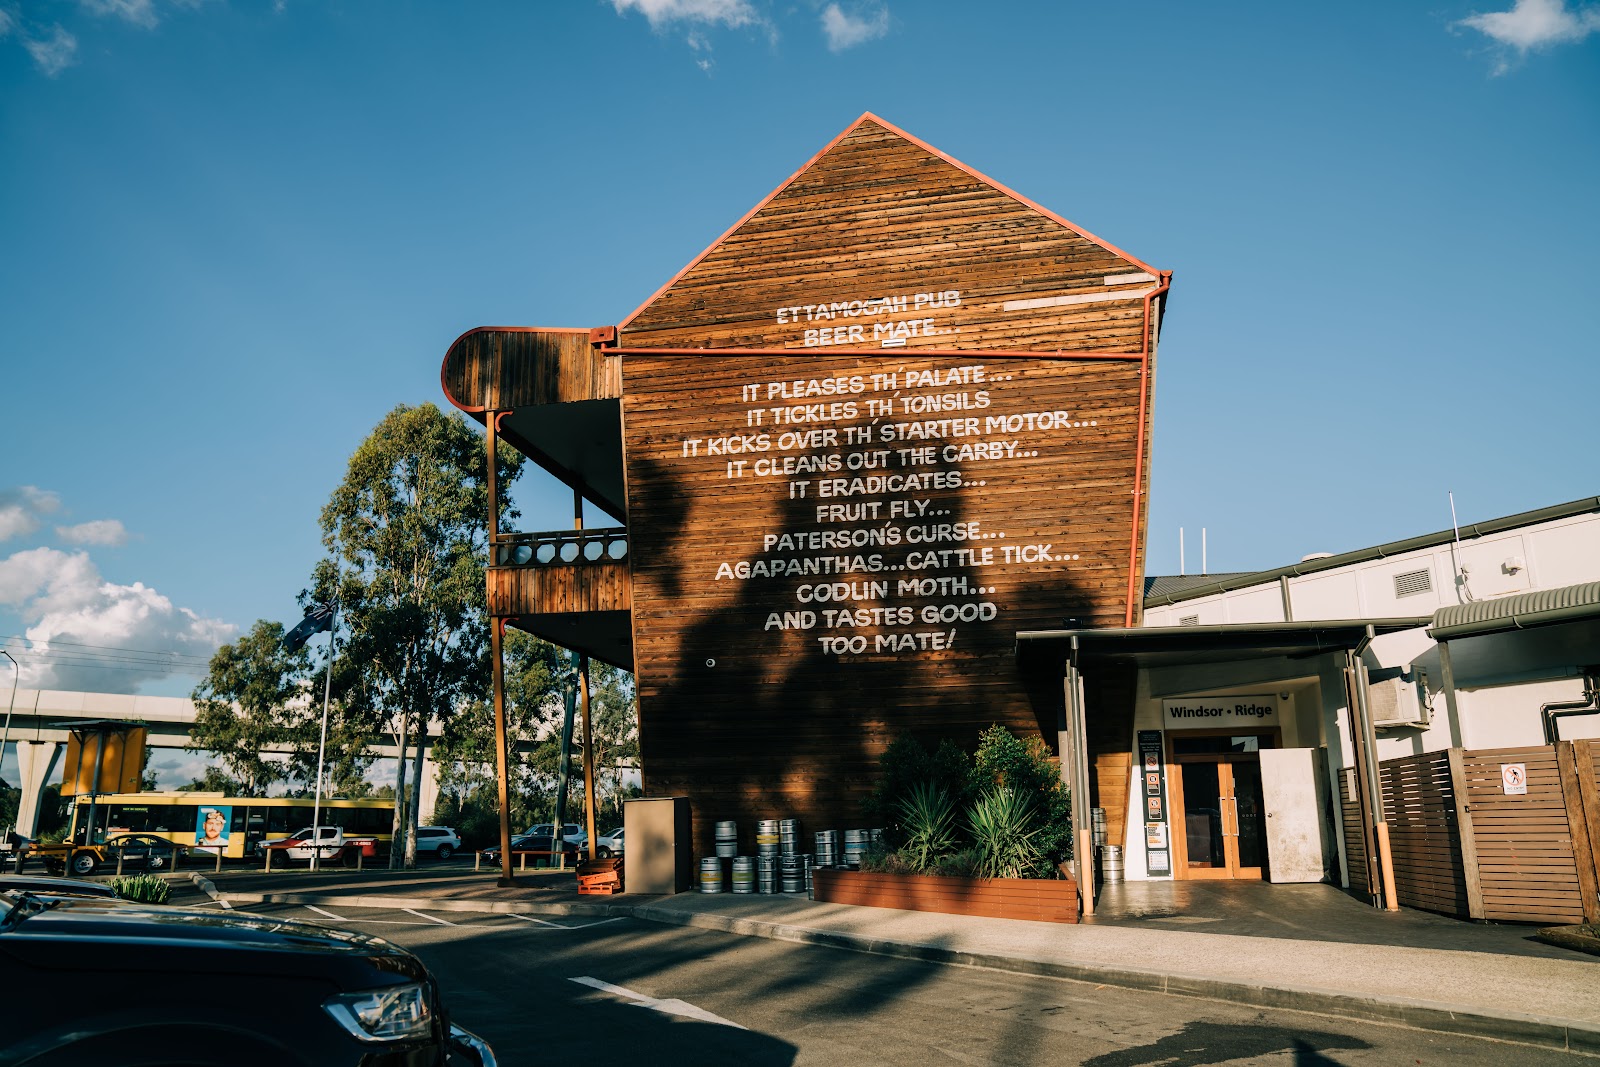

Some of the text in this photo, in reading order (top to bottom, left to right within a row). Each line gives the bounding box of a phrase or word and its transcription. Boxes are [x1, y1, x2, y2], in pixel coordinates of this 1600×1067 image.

[914, 291, 961, 310] PUB
[803, 325, 866, 347] BEER
[743, 384, 760, 402] IT
[768, 376, 865, 400] PLEASES
[747, 409, 765, 427] IT
[770, 402, 858, 424] TICKLES
[902, 391, 990, 414] TONSILS
[680, 439, 702, 457] IT
[708, 434, 771, 455] KICKS
[778, 429, 838, 450] OVER
[880, 418, 980, 442] STARTER
[986, 411, 1097, 434] MOTOR...
[727, 440, 1040, 479] IT CLEANS OUT THE CARBY...
[790, 471, 986, 499] IT ERADICATES...
[817, 499, 950, 523] FRUIT FLY...
[764, 520, 1005, 552] PATERSON'S CURSE...
[1000, 544, 1079, 564] TICK...
[898, 577, 995, 596] MOTH...
[764, 602, 997, 631] AND TASTES GOOD
[818, 628, 956, 655] TOO MATE!
[1170, 704, 1272, 718] Windsor Ridge
